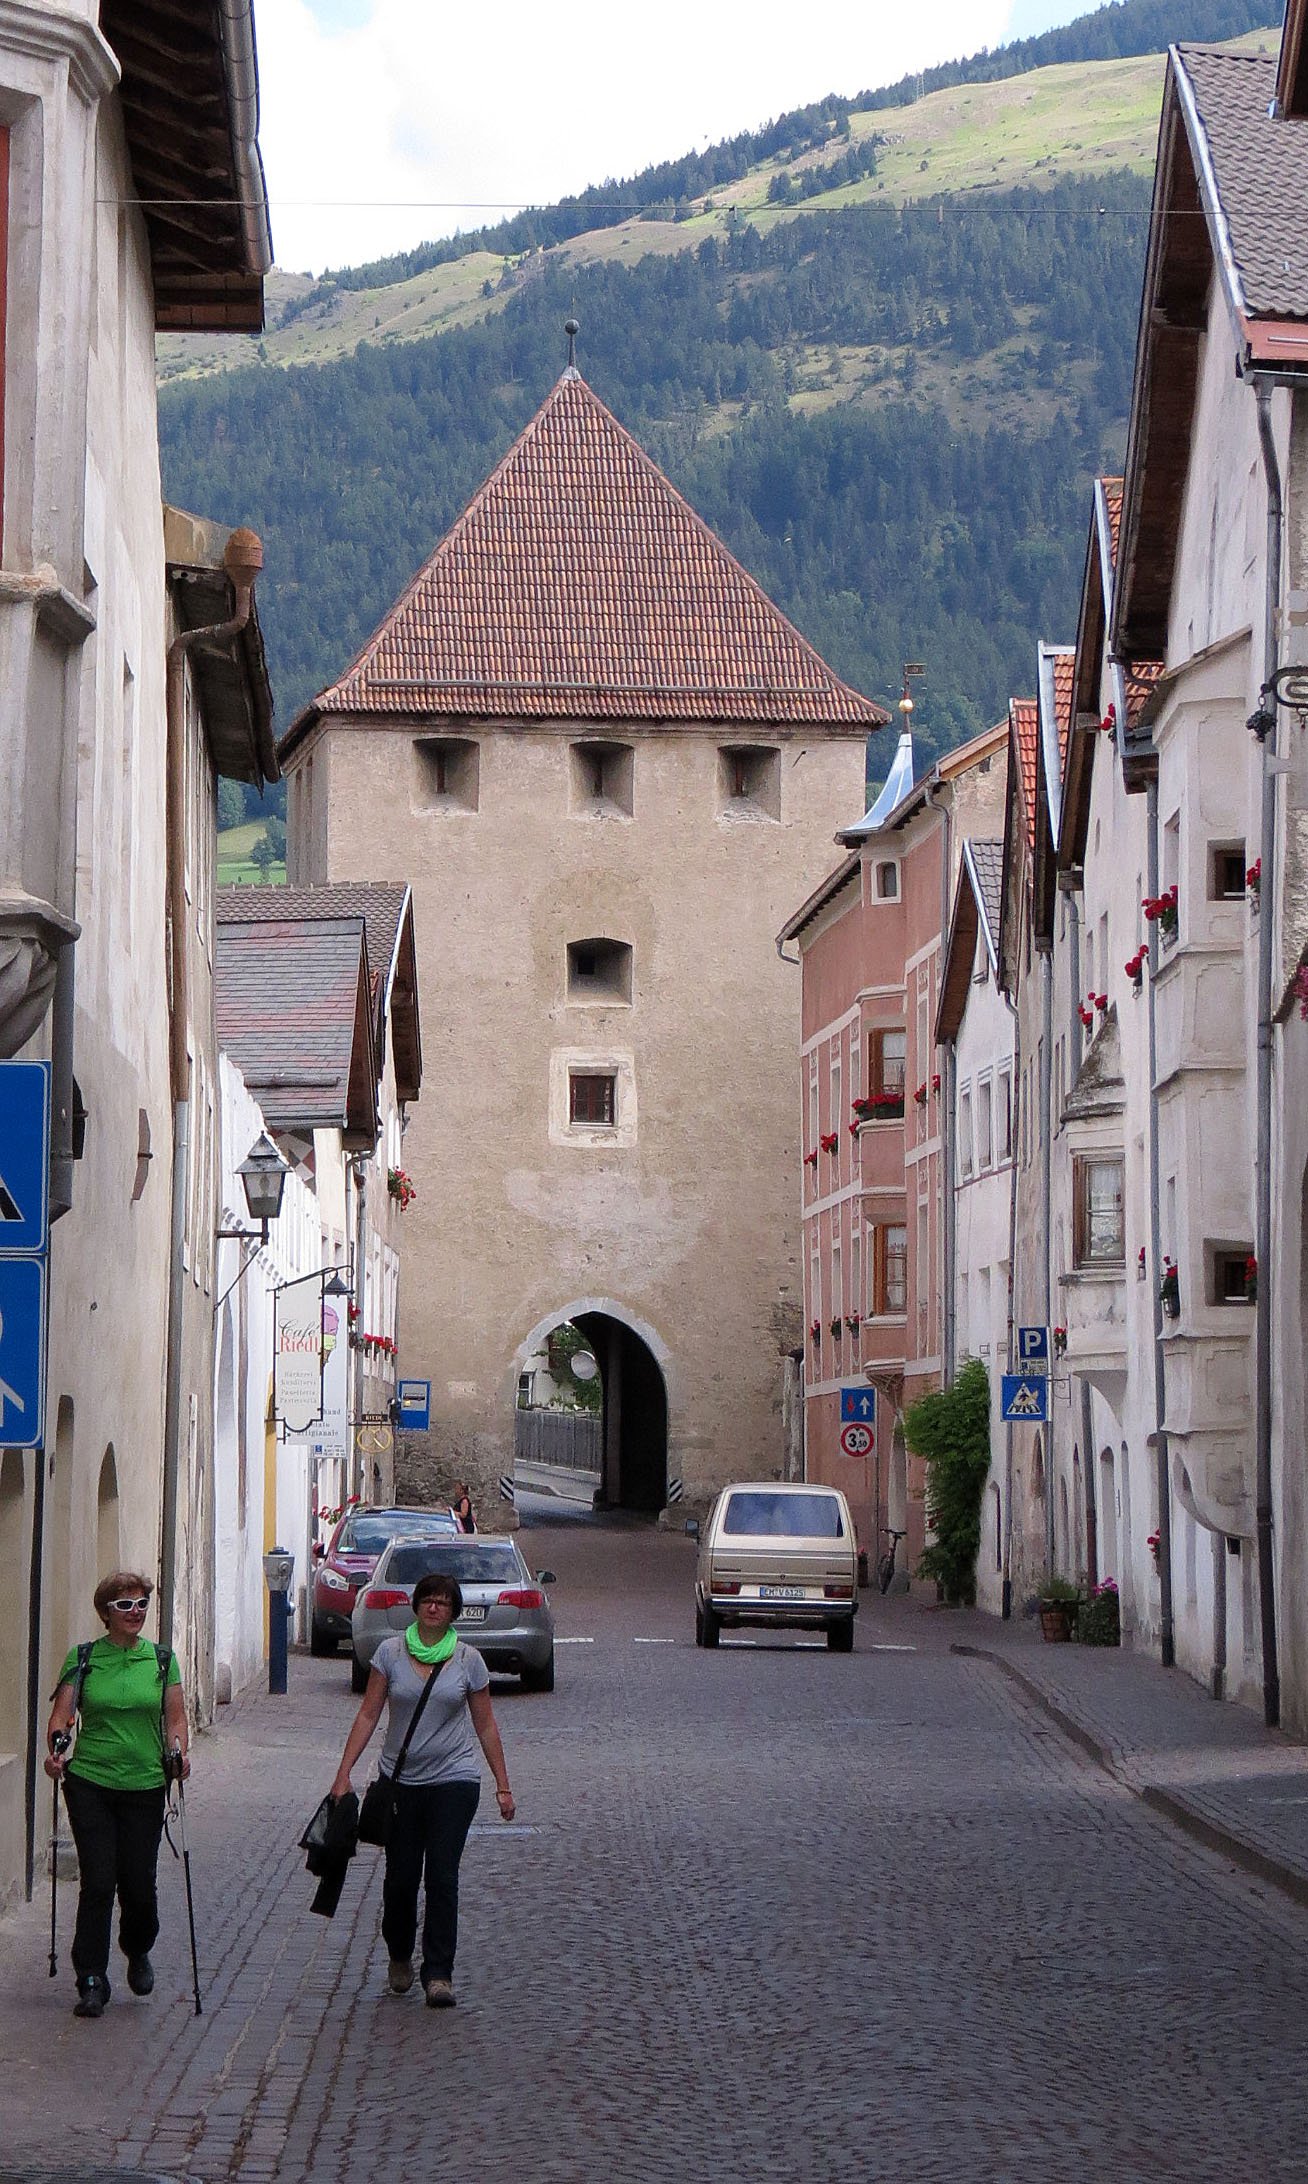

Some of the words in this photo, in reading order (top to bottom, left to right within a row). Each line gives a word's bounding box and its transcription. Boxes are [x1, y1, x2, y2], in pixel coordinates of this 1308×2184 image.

[278, 1318, 320, 1343] Café
[1024, 1330, 1041, 1356] P
[280, 1336, 318, 1352] Riedl
